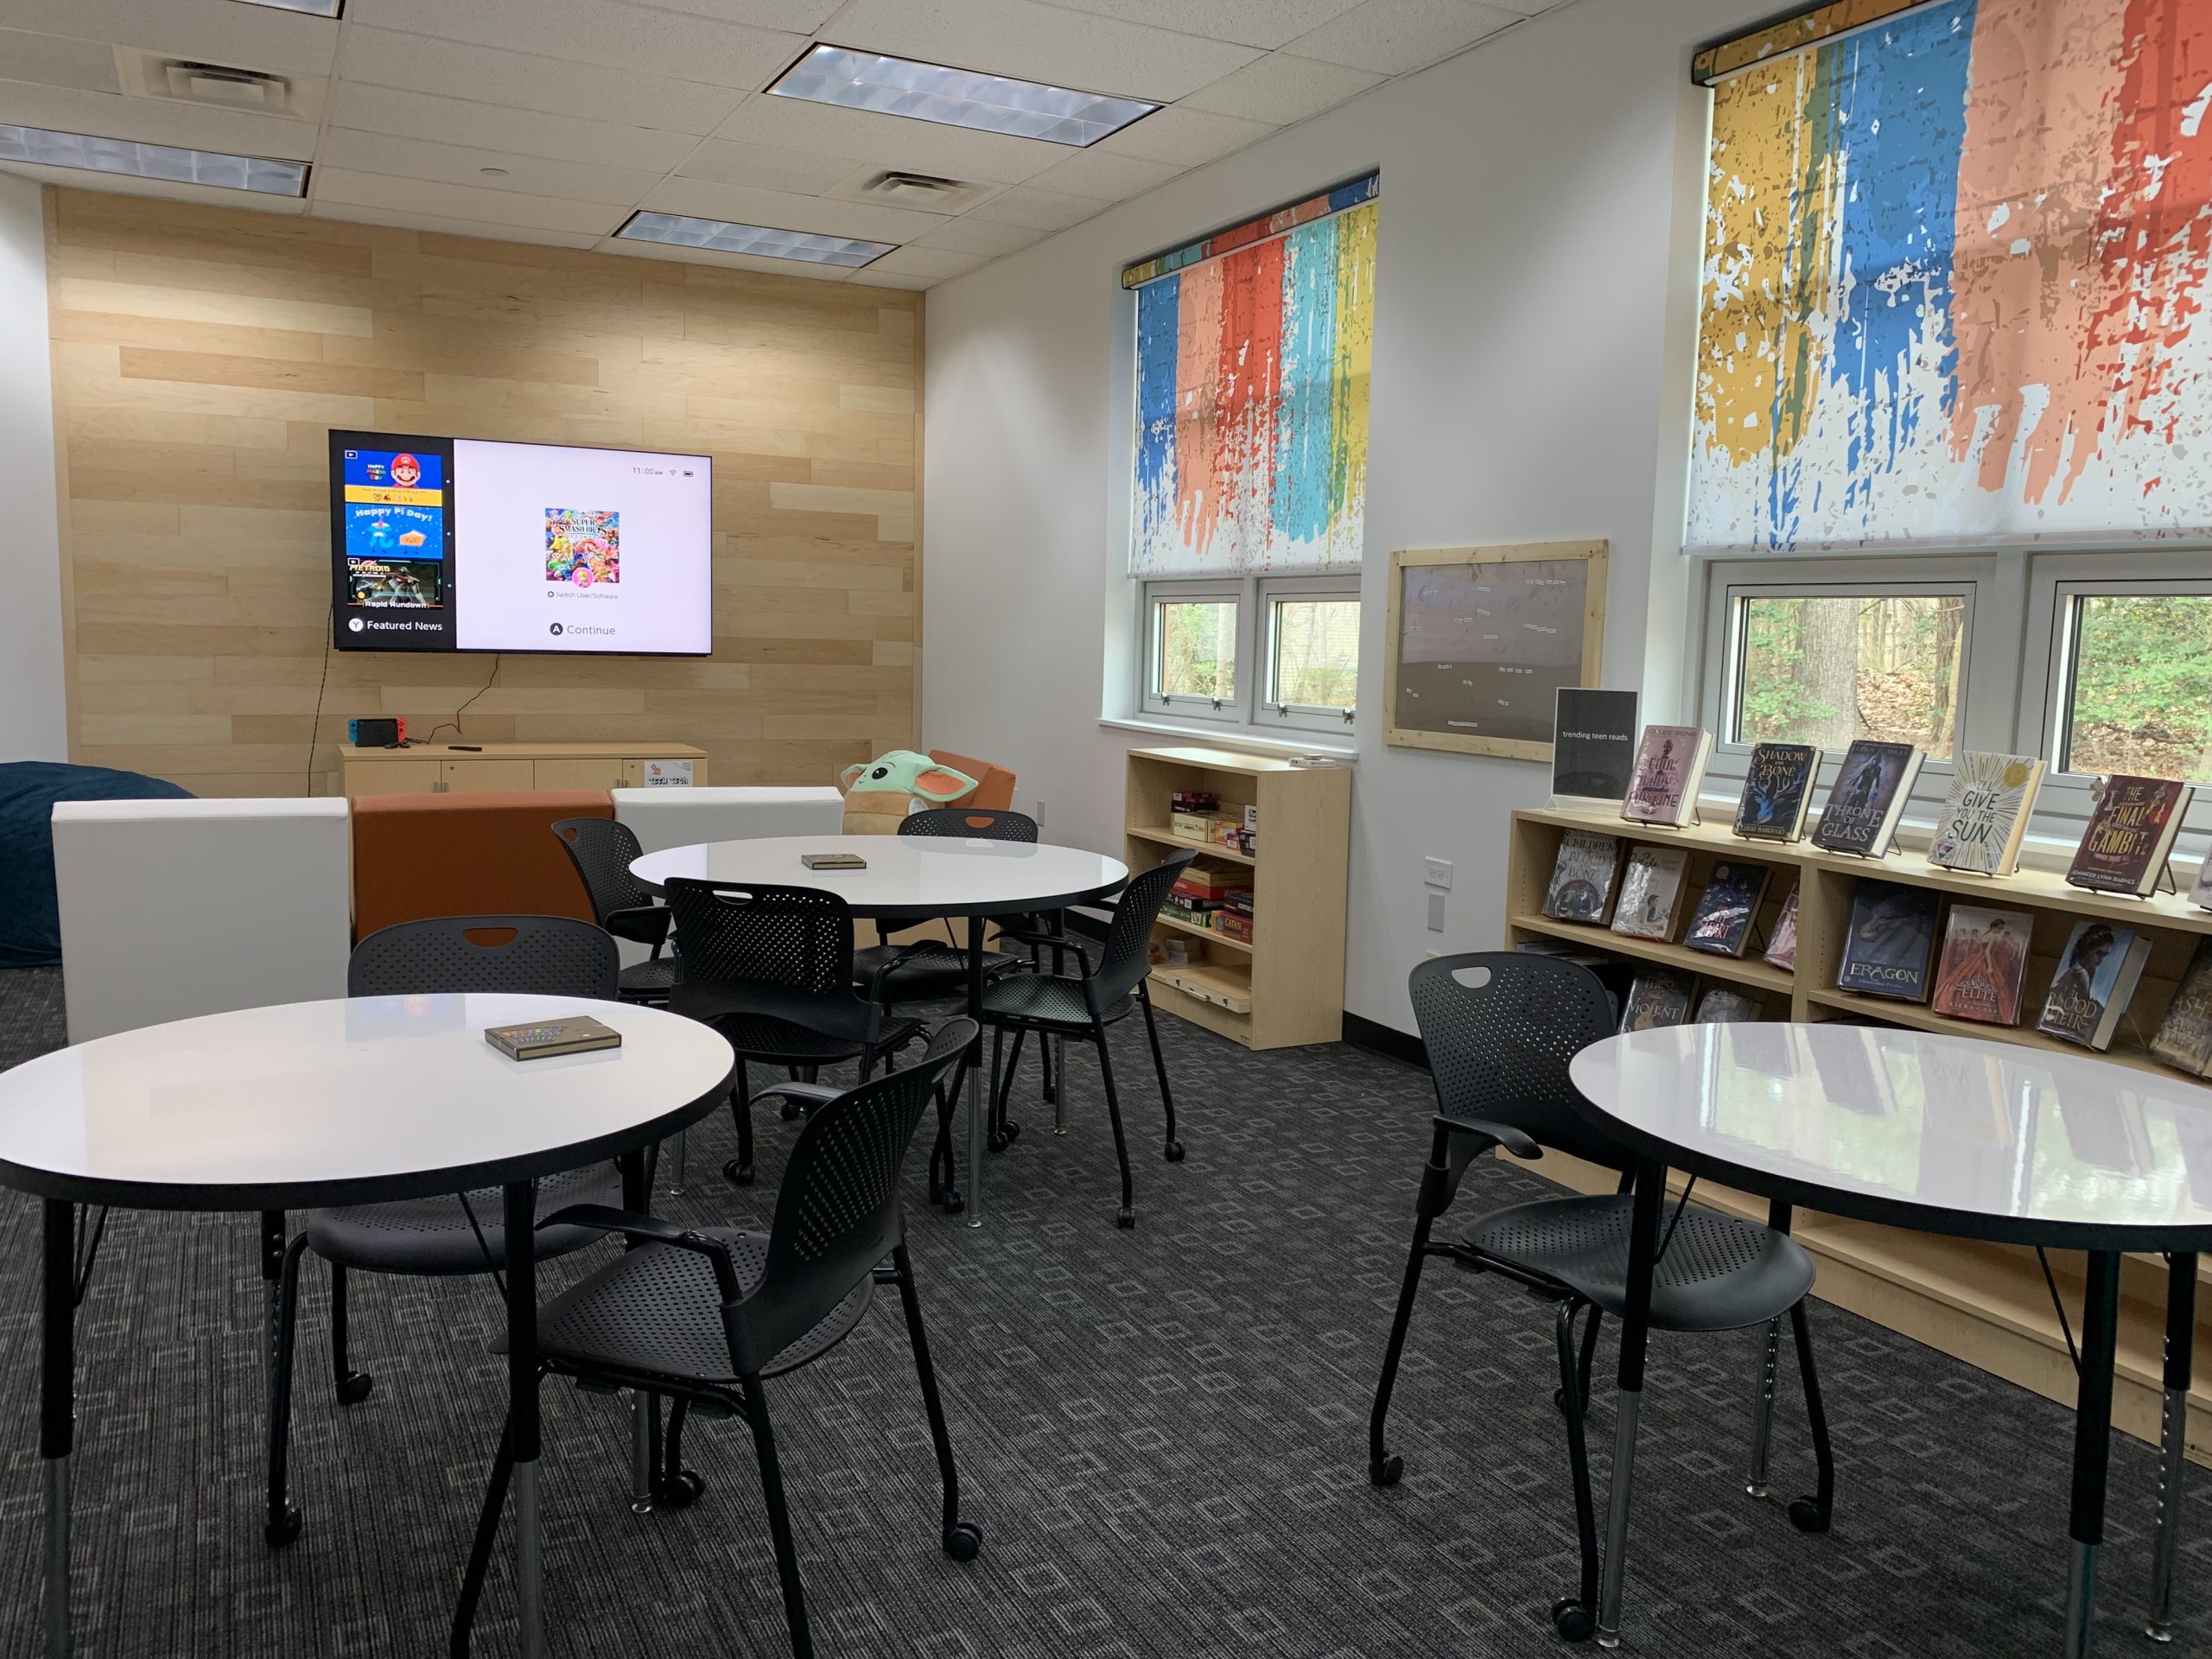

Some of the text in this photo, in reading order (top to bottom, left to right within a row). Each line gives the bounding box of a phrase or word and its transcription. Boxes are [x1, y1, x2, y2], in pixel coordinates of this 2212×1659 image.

[632, 467, 654, 475] 11:00
[355, 507, 433, 522] Happy Pi Day!
[559, 524, 585, 533] SMASH
[366, 620, 412, 631] Featured
[415, 621, 443, 631] News
[567, 625, 616, 635] Continue
[1562, 731, 1591, 741] trending
[1608, 733, 1629, 741] reads
[1755, 748, 1807, 765] SHADOW
[1759, 764, 1796, 779] BONE
[649, 777, 668, 785] TEEN
[1962, 790, 2000, 810] GIVE
[2123, 786, 2145, 802] THE
[1823, 803, 1885, 828] THRONE
[1843, 816, 1856, 825] OF
[1956, 807, 1998, 823] YOU THE
[2108, 805, 2146, 827] FINAL
[1821, 822, 1871, 842] GLASS
[1948, 819, 1993, 844] SUN
[2088, 828, 2150, 855] GAMBIT
[1224, 917, 1243, 931] CATAN
[1850, 963, 1919, 984] ERAGON
[1644, 976, 1680, 993] THESE
[1961, 988, 1998, 1002] ELITE
[1628, 997, 1681, 1020] VIOLENT
[1949, 1001, 1974, 1010] KIERA
